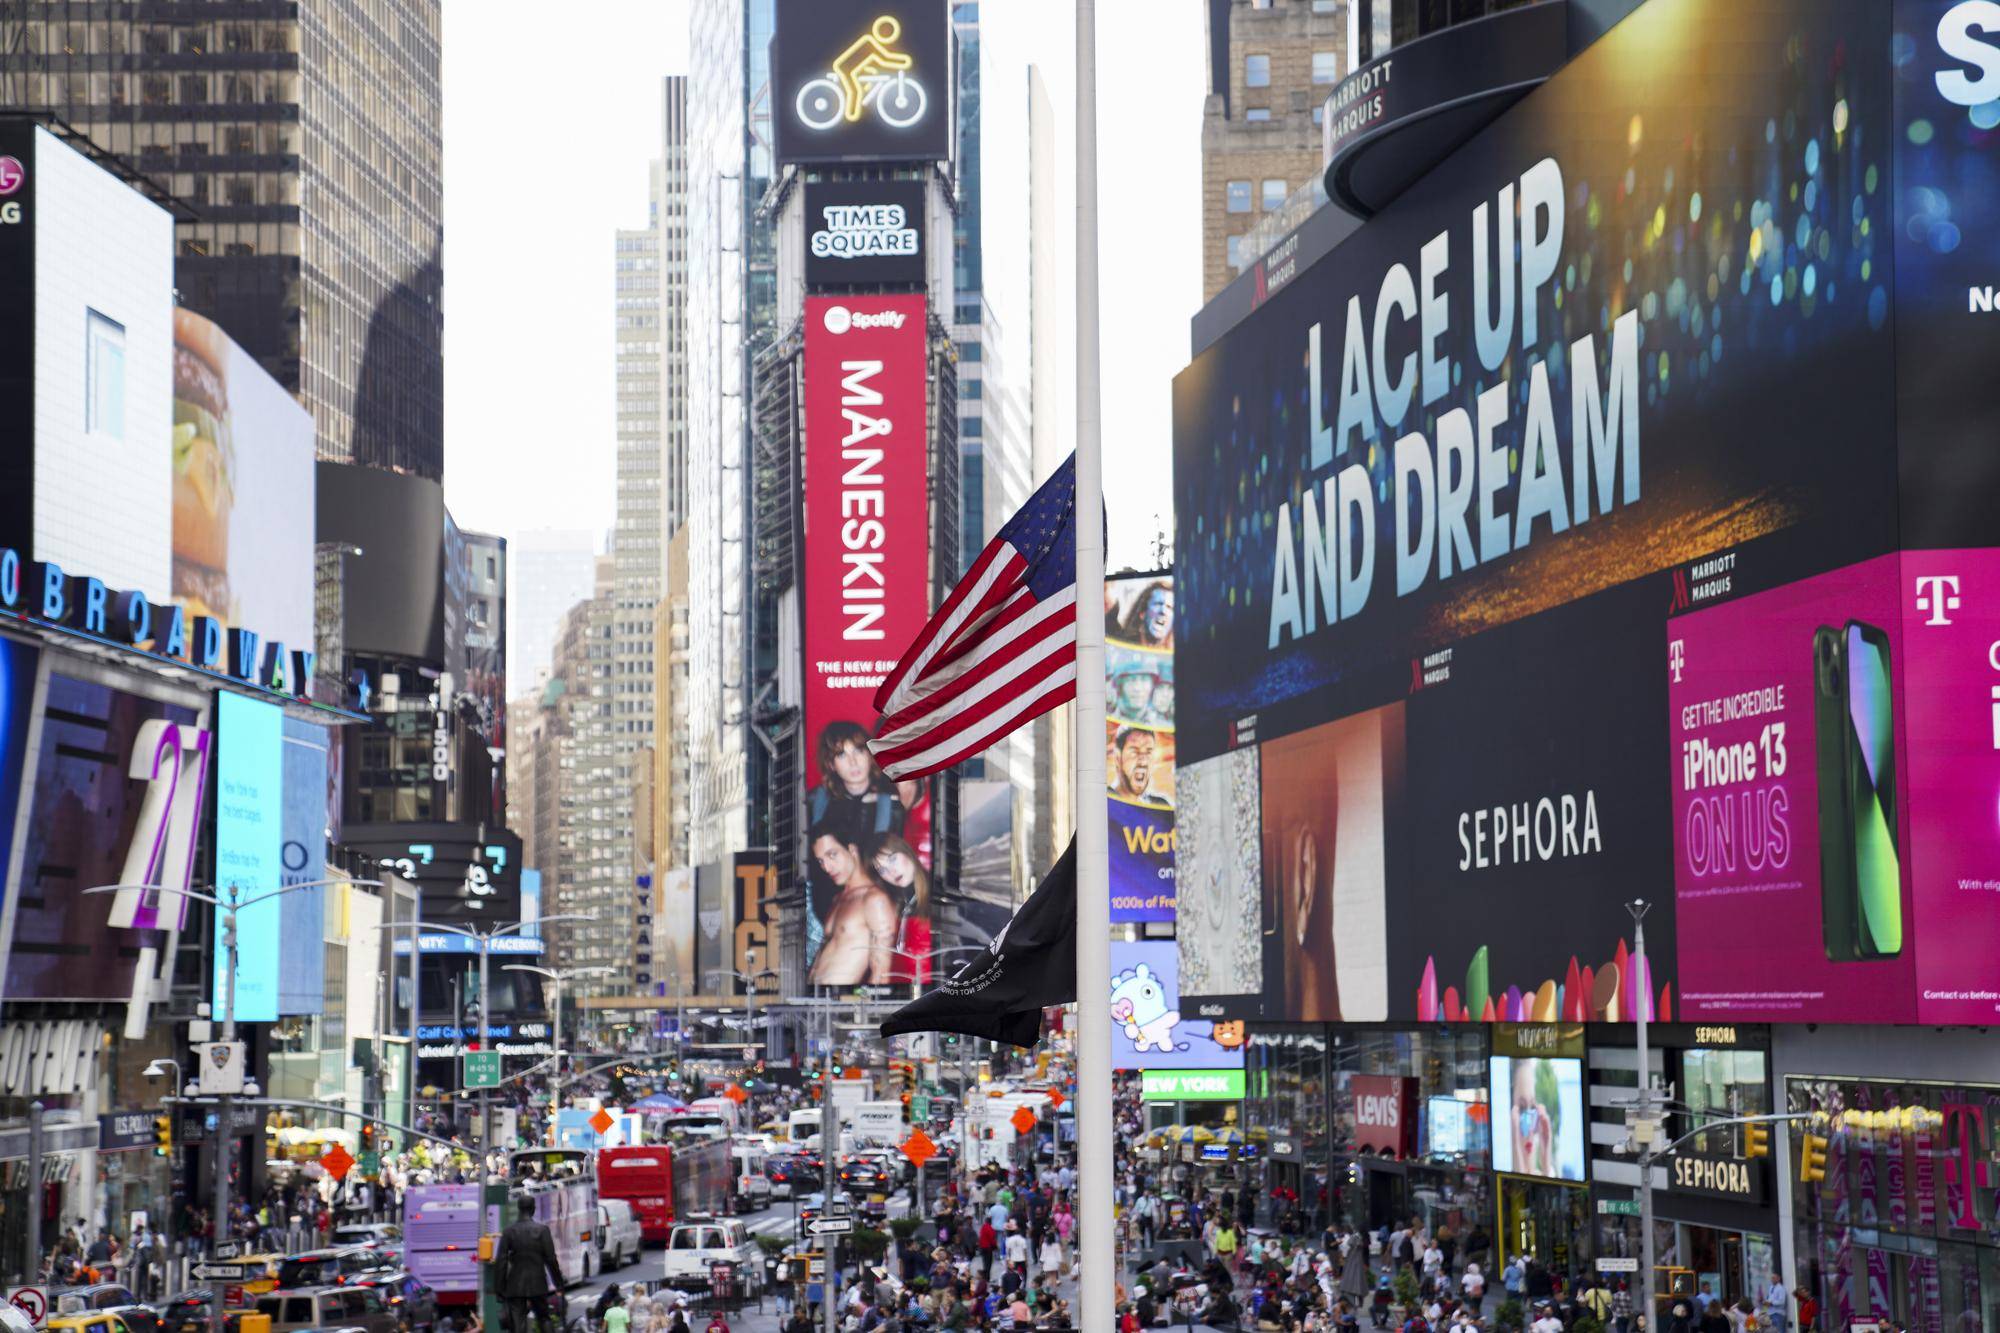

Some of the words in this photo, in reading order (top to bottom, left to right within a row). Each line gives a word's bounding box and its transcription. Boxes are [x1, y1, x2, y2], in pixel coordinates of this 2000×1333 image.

[1330, 60, 1392, 113] MARRIOTT
[1330, 95, 1382, 142] MARQUIS
[0, 201, 21, 224] G
[825, 206, 903, 229] TIMES
[813, 230, 916, 256] SQUARE
[1267, 234, 1298, 272] MARRIOTT
[1267, 259, 1295, 291] MARQUIS
[852, 310, 906, 329] Spotify
[1308, 230, 1450, 470] LACE
[1472, 157, 1565, 372] UP
[1268, 464, 1376, 650] AND
[1394, 308, 1641, 598] DREAM
[841, 360, 893, 640] MÅNESKIN
[1692, 553, 1737, 581] MARRIOTT
[1692, 578, 1732, 602] MARQUIS
[43, 562, 316, 699] BROADWAY
[816, 661, 841, 673] THE
[843, 661, 873, 673] NEW
[1682, 704, 1700, 730] GET
[1702, 699, 1722, 725] THE
[1723, 684, 1785, 721] INCREDIBLE
[433, 712, 448, 781] 1500
[1683, 737, 1757, 791] iPhone
[1760, 721, 1787, 777] 13
[1458, 790, 1602, 871] SEPHORA
[1686, 794, 1736, 877] ON
[1742, 785, 1791, 871] US
[1923, 990, 1958, 1000] Contact
[1959, 992, 1969, 1000] us
[1970, 990, 1998, 1000] before
[1695, 1026, 1736, 1043] SEPHORA
[1181, 1077, 1229, 1092] YORK
[1675, 1156, 1751, 1193] SEPHORA
